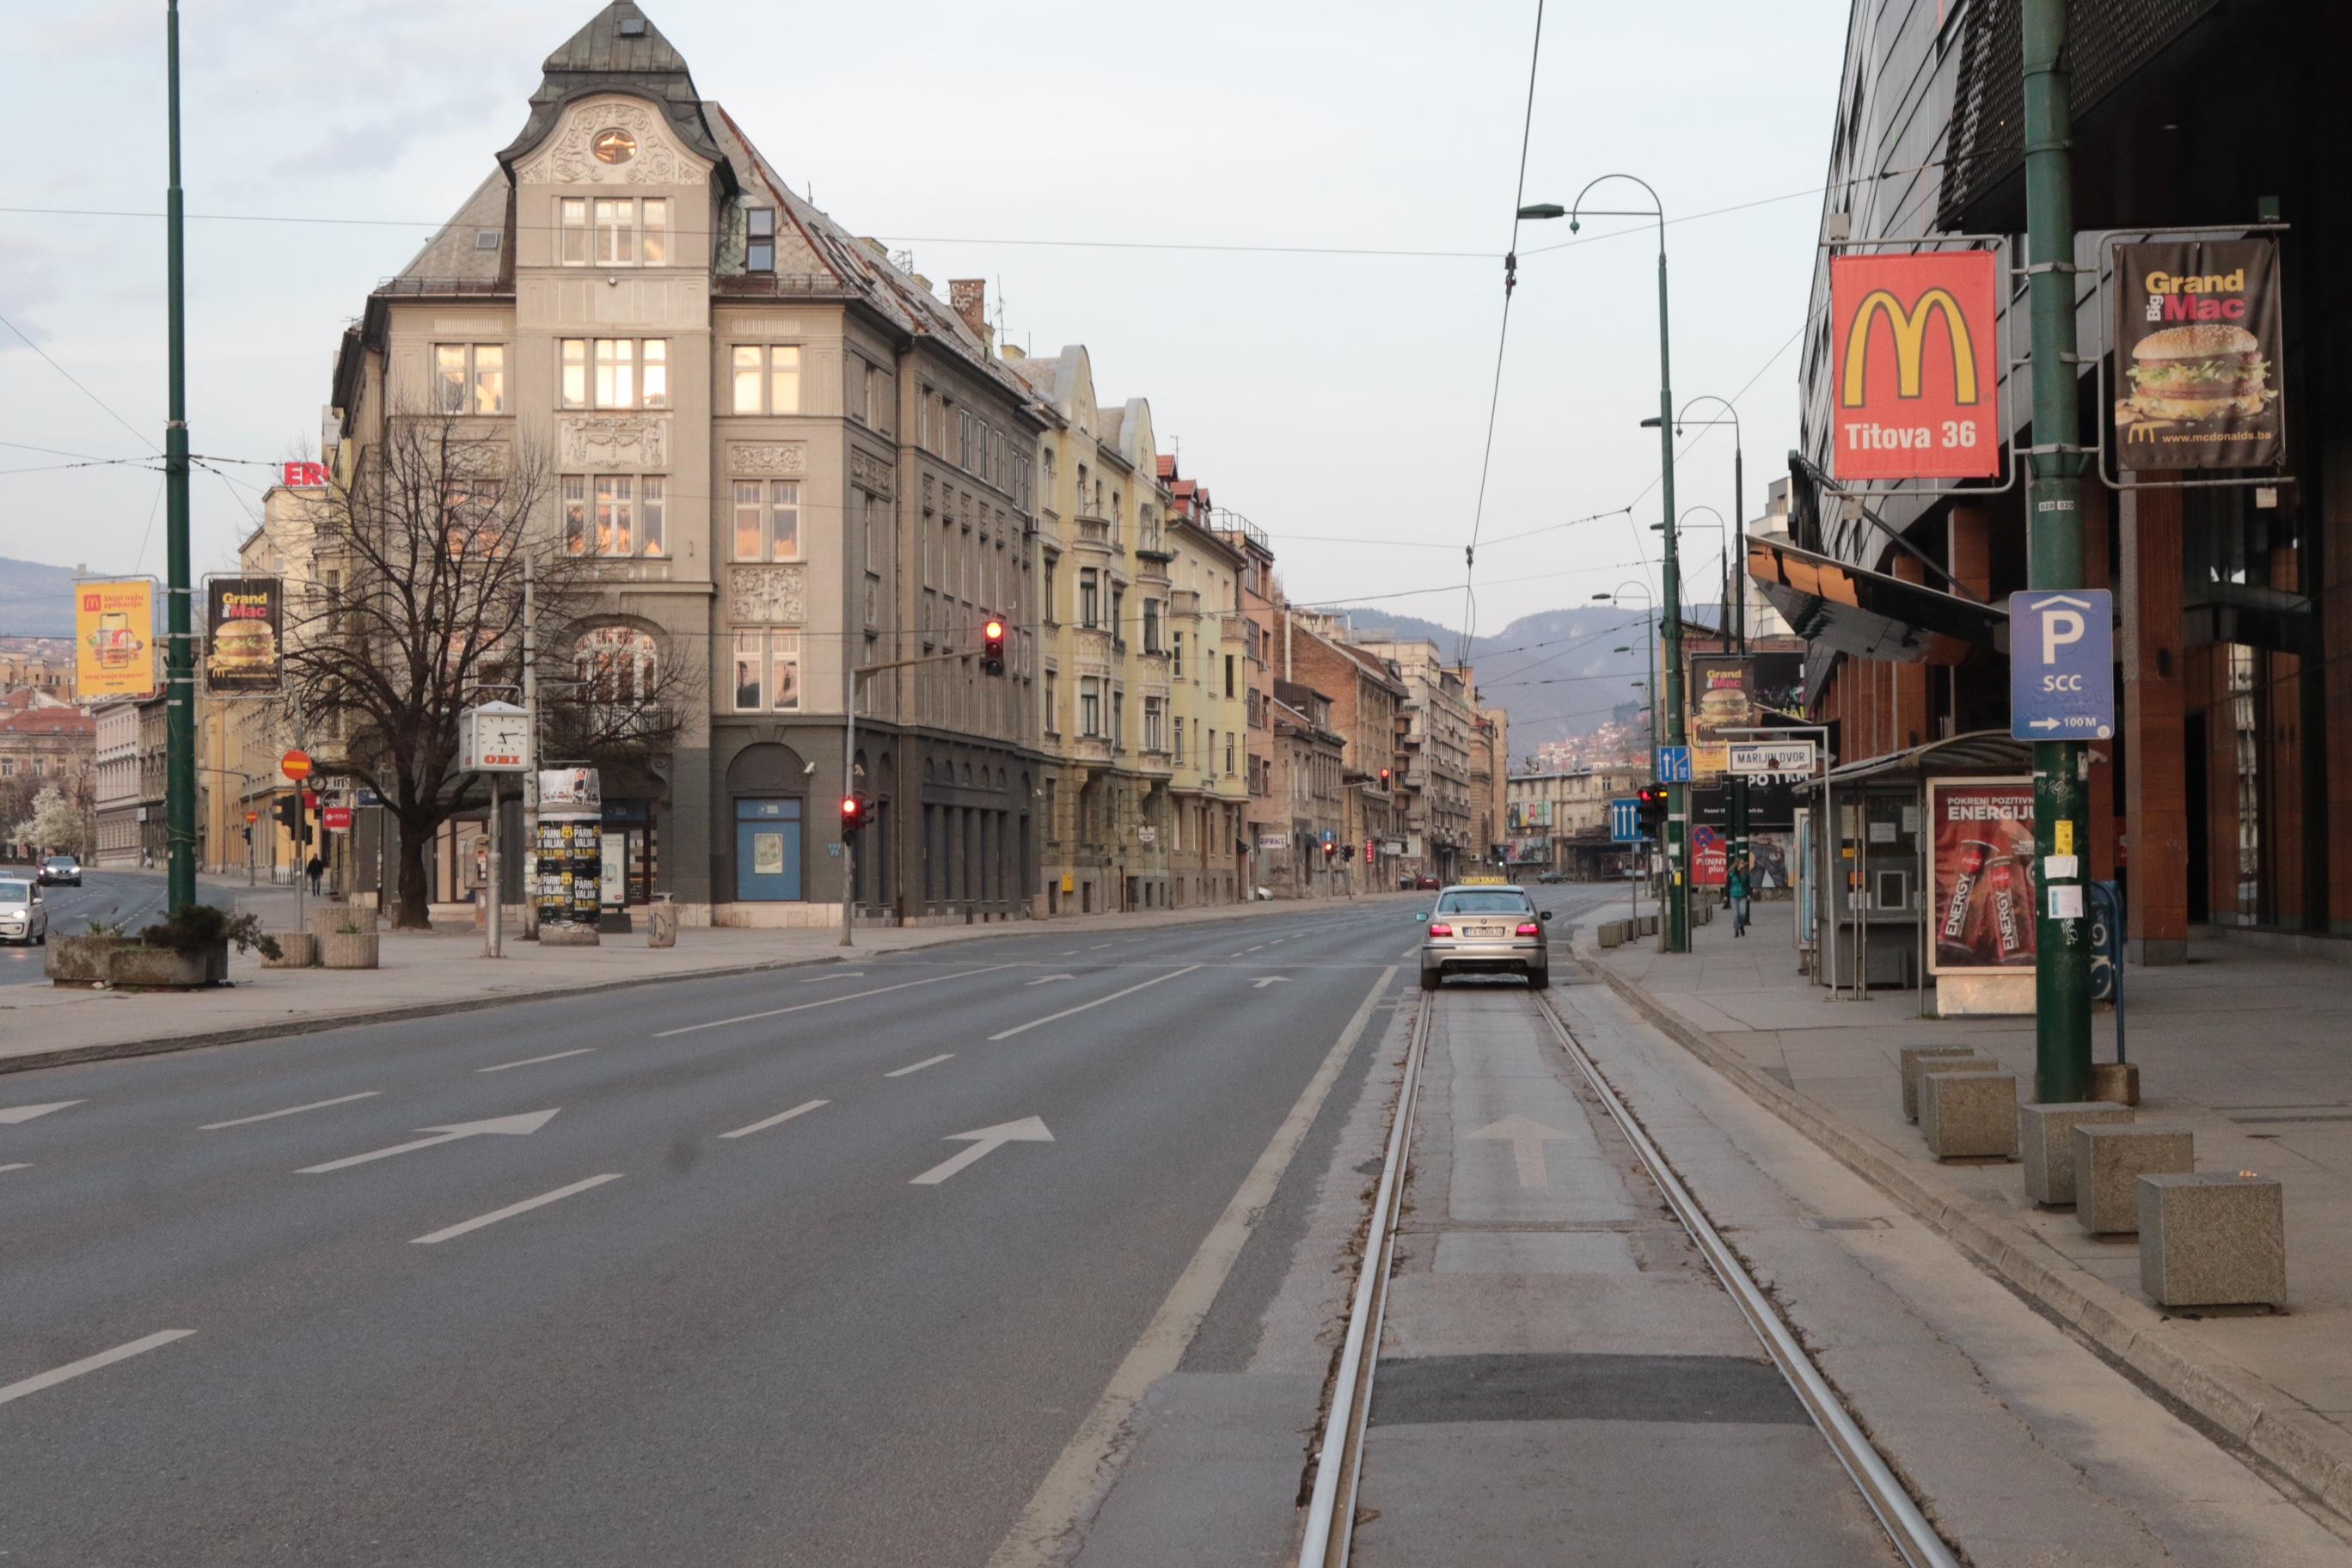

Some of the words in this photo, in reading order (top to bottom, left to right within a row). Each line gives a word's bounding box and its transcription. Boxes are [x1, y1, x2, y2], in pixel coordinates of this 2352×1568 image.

[2146, 268, 2245, 294] Grand
[2146, 294, 2164, 322] Big
[2164, 294, 2245, 322] Mac
[1844, 422, 1932, 450] Titova
[1941, 420, 1976, 448] 36
[2162, 431, 2272, 443] www.mcdonalds.ba
[222, 591, 268, 604] Grand
[230, 604, 267, 617] Mac
[2042, 610, 2085, 665] P
[1706, 669, 1743, 678] Grand
[2043, 674, 2082, 692] SCC
[483, 755, 520, 765] OBI
[1779, 751, 1805, 763] DVOR
[1748, 774, 1769, 787] PO
[1947, 797, 1989, 805] POKRENI
[543, 829, 561, 839] PARNI
[574, 829, 593, 838] PARNI
[543, 839, 566, 848] VALJAK
[1708, 866, 1724, 874] plus
[542, 875, 561, 885] PARNI
[574, 879, 594, 890] PARNI
[543, 885, 565, 895] VALJAK
[1945, 873, 1971, 937] ENERGY
[1995, 891, 2014, 952] ENERGY
